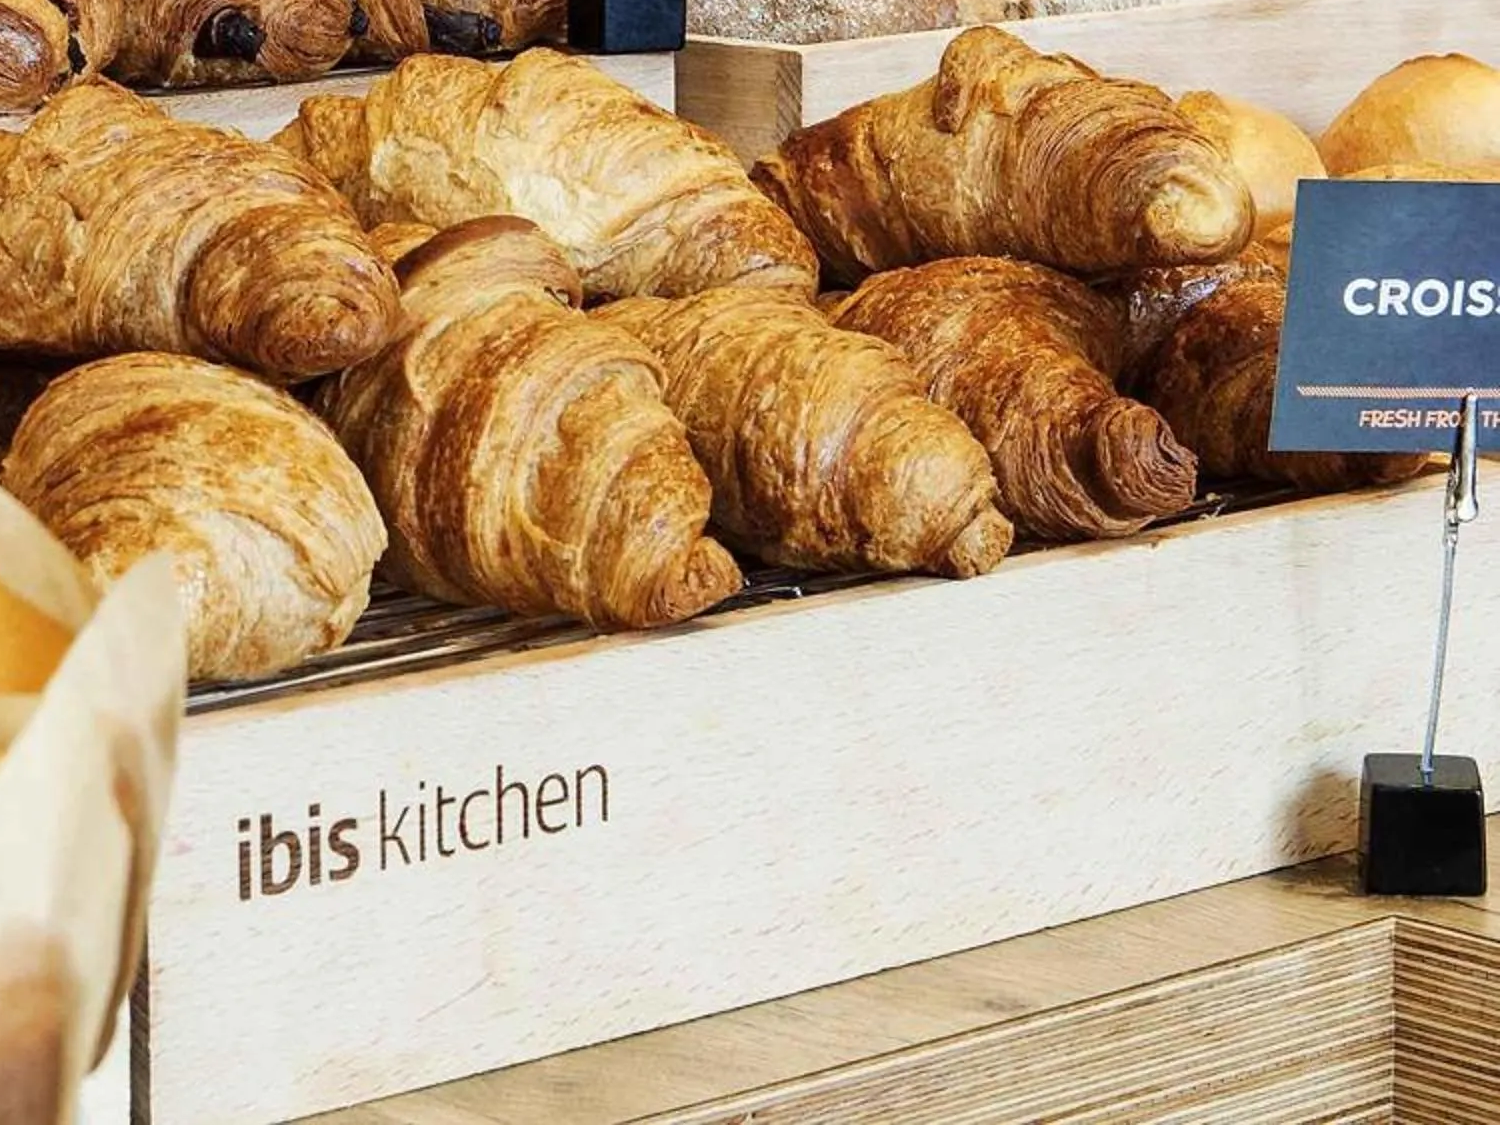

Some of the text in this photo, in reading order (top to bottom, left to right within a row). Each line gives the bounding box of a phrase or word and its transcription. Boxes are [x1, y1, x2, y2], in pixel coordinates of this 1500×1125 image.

[1343, 277, 1500, 317] CROIS
[1358, 409, 1421, 428] FRESH
[1425, 409, 1468, 428] FRO
[237, 764, 609, 901] ibis kitchen
